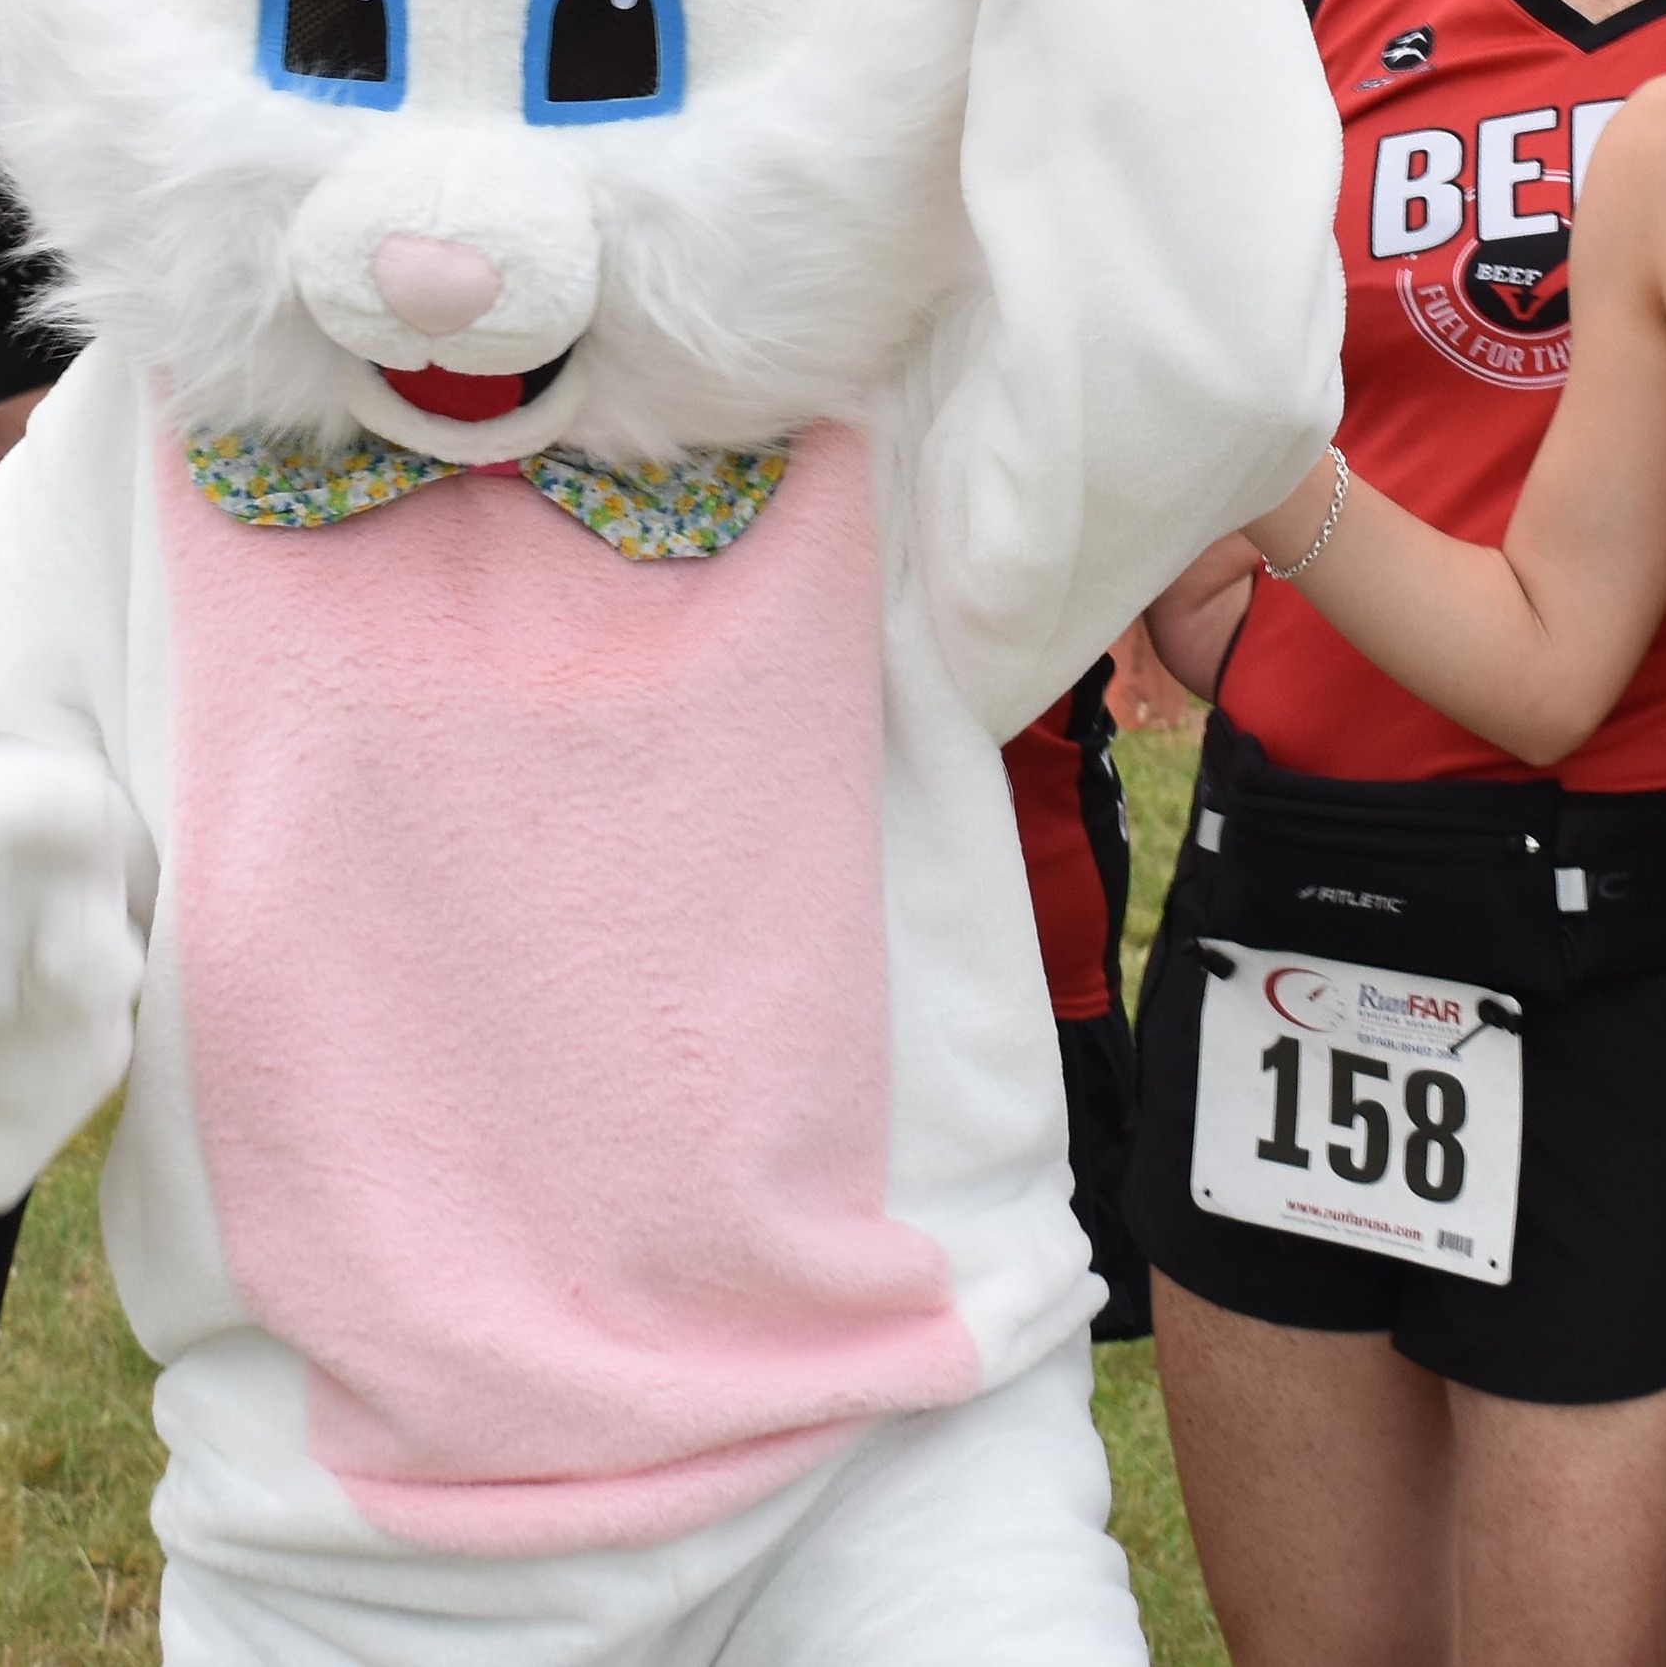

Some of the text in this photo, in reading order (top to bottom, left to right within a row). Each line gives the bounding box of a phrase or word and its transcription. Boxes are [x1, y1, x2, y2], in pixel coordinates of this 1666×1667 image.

[1474, 262, 1543, 286] BEEF
[1418, 284, 1573, 373] FUEL FOR TH
[1359, 983, 1462, 1026] RunFAR
[1257, 1034, 1467, 1203] 158
